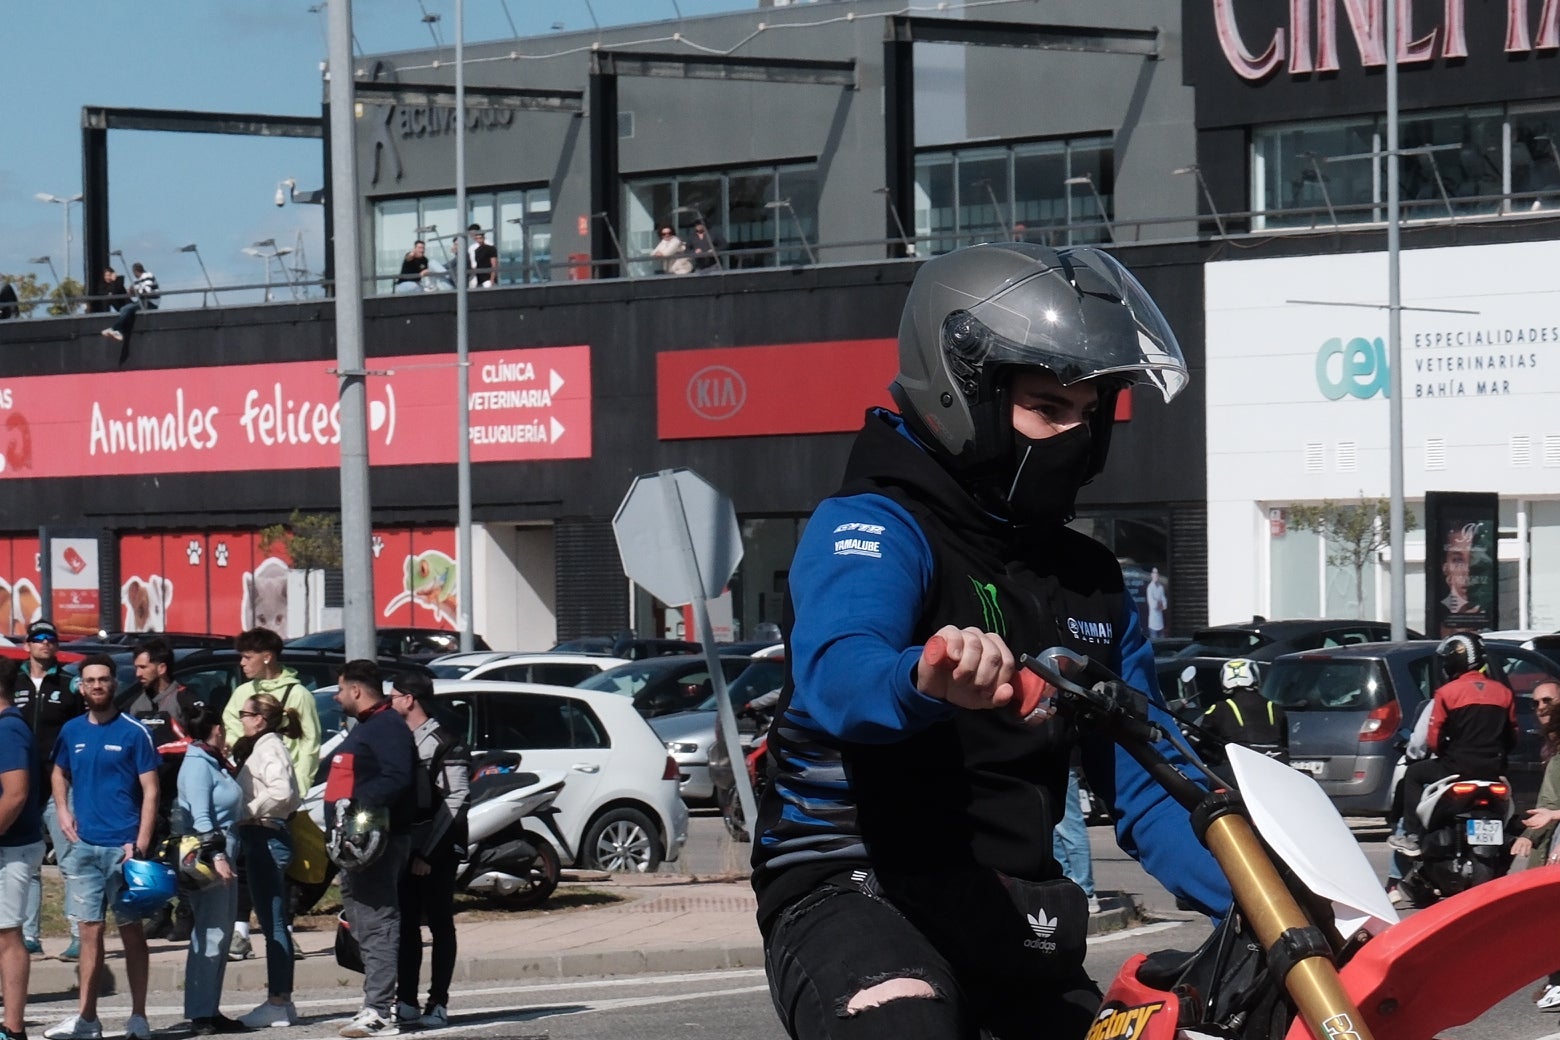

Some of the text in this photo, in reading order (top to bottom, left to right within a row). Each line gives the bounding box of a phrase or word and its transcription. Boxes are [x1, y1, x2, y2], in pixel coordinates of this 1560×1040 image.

[1414, 327, 1560, 348] ESPECIALIDADES
[482, 359, 537, 384] CLÍNICA
[1415, 353, 1537, 372] VETERINARIAS
[697, 377, 737, 408] KIA
[1416, 379, 1511, 398] BAHÍA MAR
[90, 388, 219, 456] Animales
[834, 538, 881, 553] YAMALUBE
[1073, 633, 1111, 645] RACIN
[1077, 620, 1113, 639] YAMAH
[1023, 939, 1057, 951] adidas
